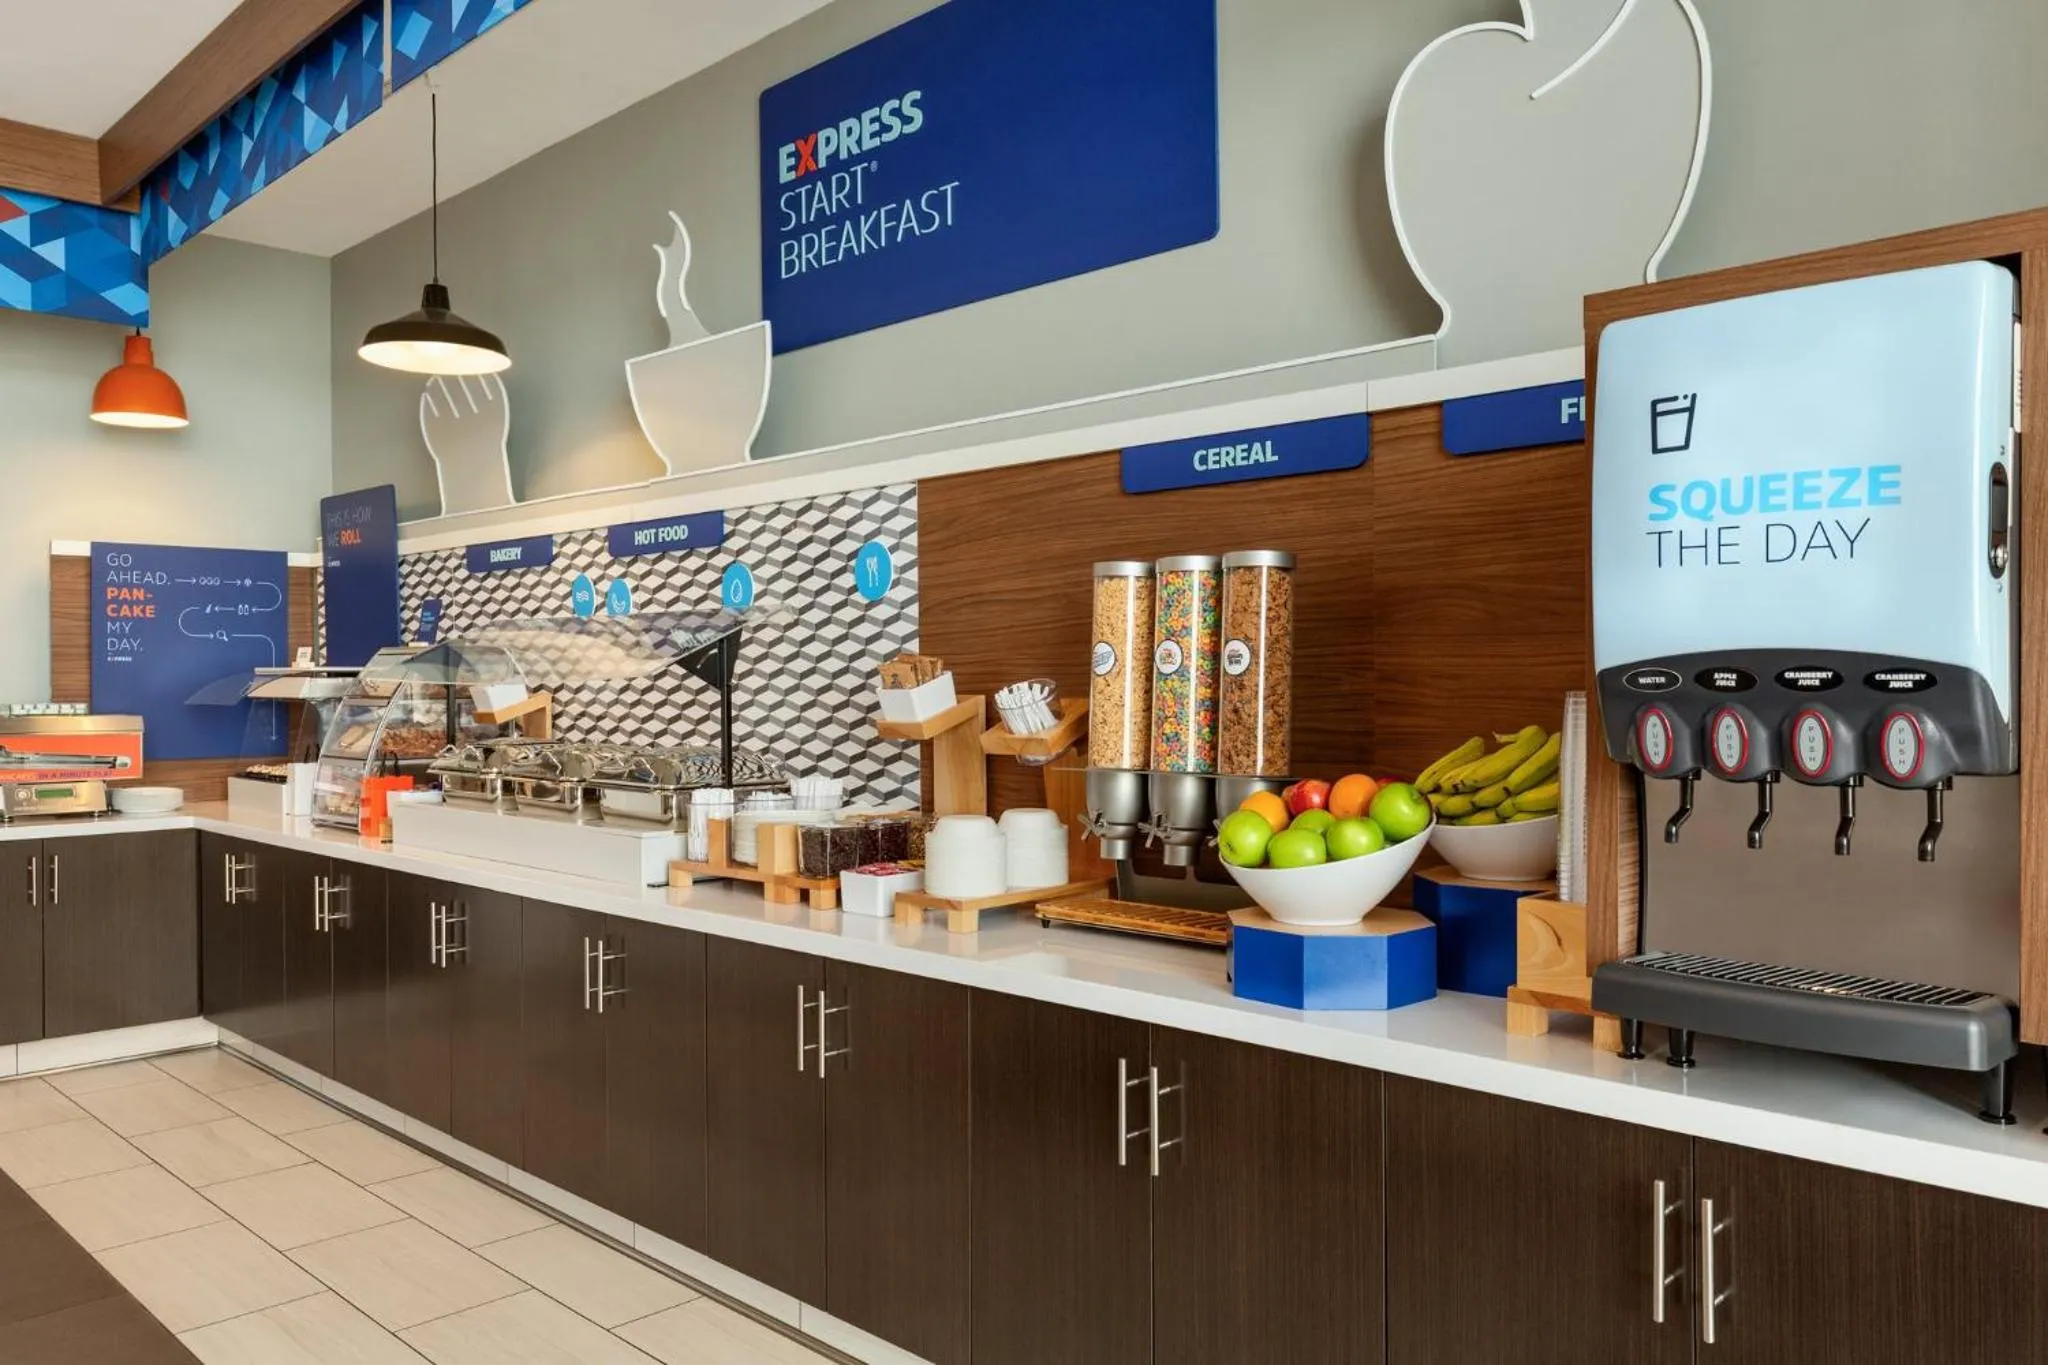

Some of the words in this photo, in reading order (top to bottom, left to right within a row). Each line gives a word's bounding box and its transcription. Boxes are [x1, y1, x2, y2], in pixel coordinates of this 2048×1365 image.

[779, 90, 923, 184] EXPRESS
[781, 182, 960, 279] BREAKFAST
[1193, 440, 1279, 471] CEREAL
[1647, 464, 1902, 522] SQUEEZE
[340, 528, 361, 544] ROLL
[634, 528, 657, 545] HOT
[659, 525, 689, 543] FOOD
[1646, 525, 1741, 568] THE
[1765, 518, 1870, 563] DAY
[107, 553, 132, 567] GO
[490, 547, 522, 563] BAKERY
[107, 570, 171, 585] AHEAD.
[107, 587, 153, 601] PAN-
[107, 604, 156, 618] CAKE
[107, 621, 132, 634] MY
[107, 638, 143, 652] DAY.
[1638, 676, 1666, 684] WATER
[1784, 671, 1833, 679] CRANBERRY
[1874, 673, 1926, 681] CRANBERRY
[1898, 727, 1906, 765] PUSH
